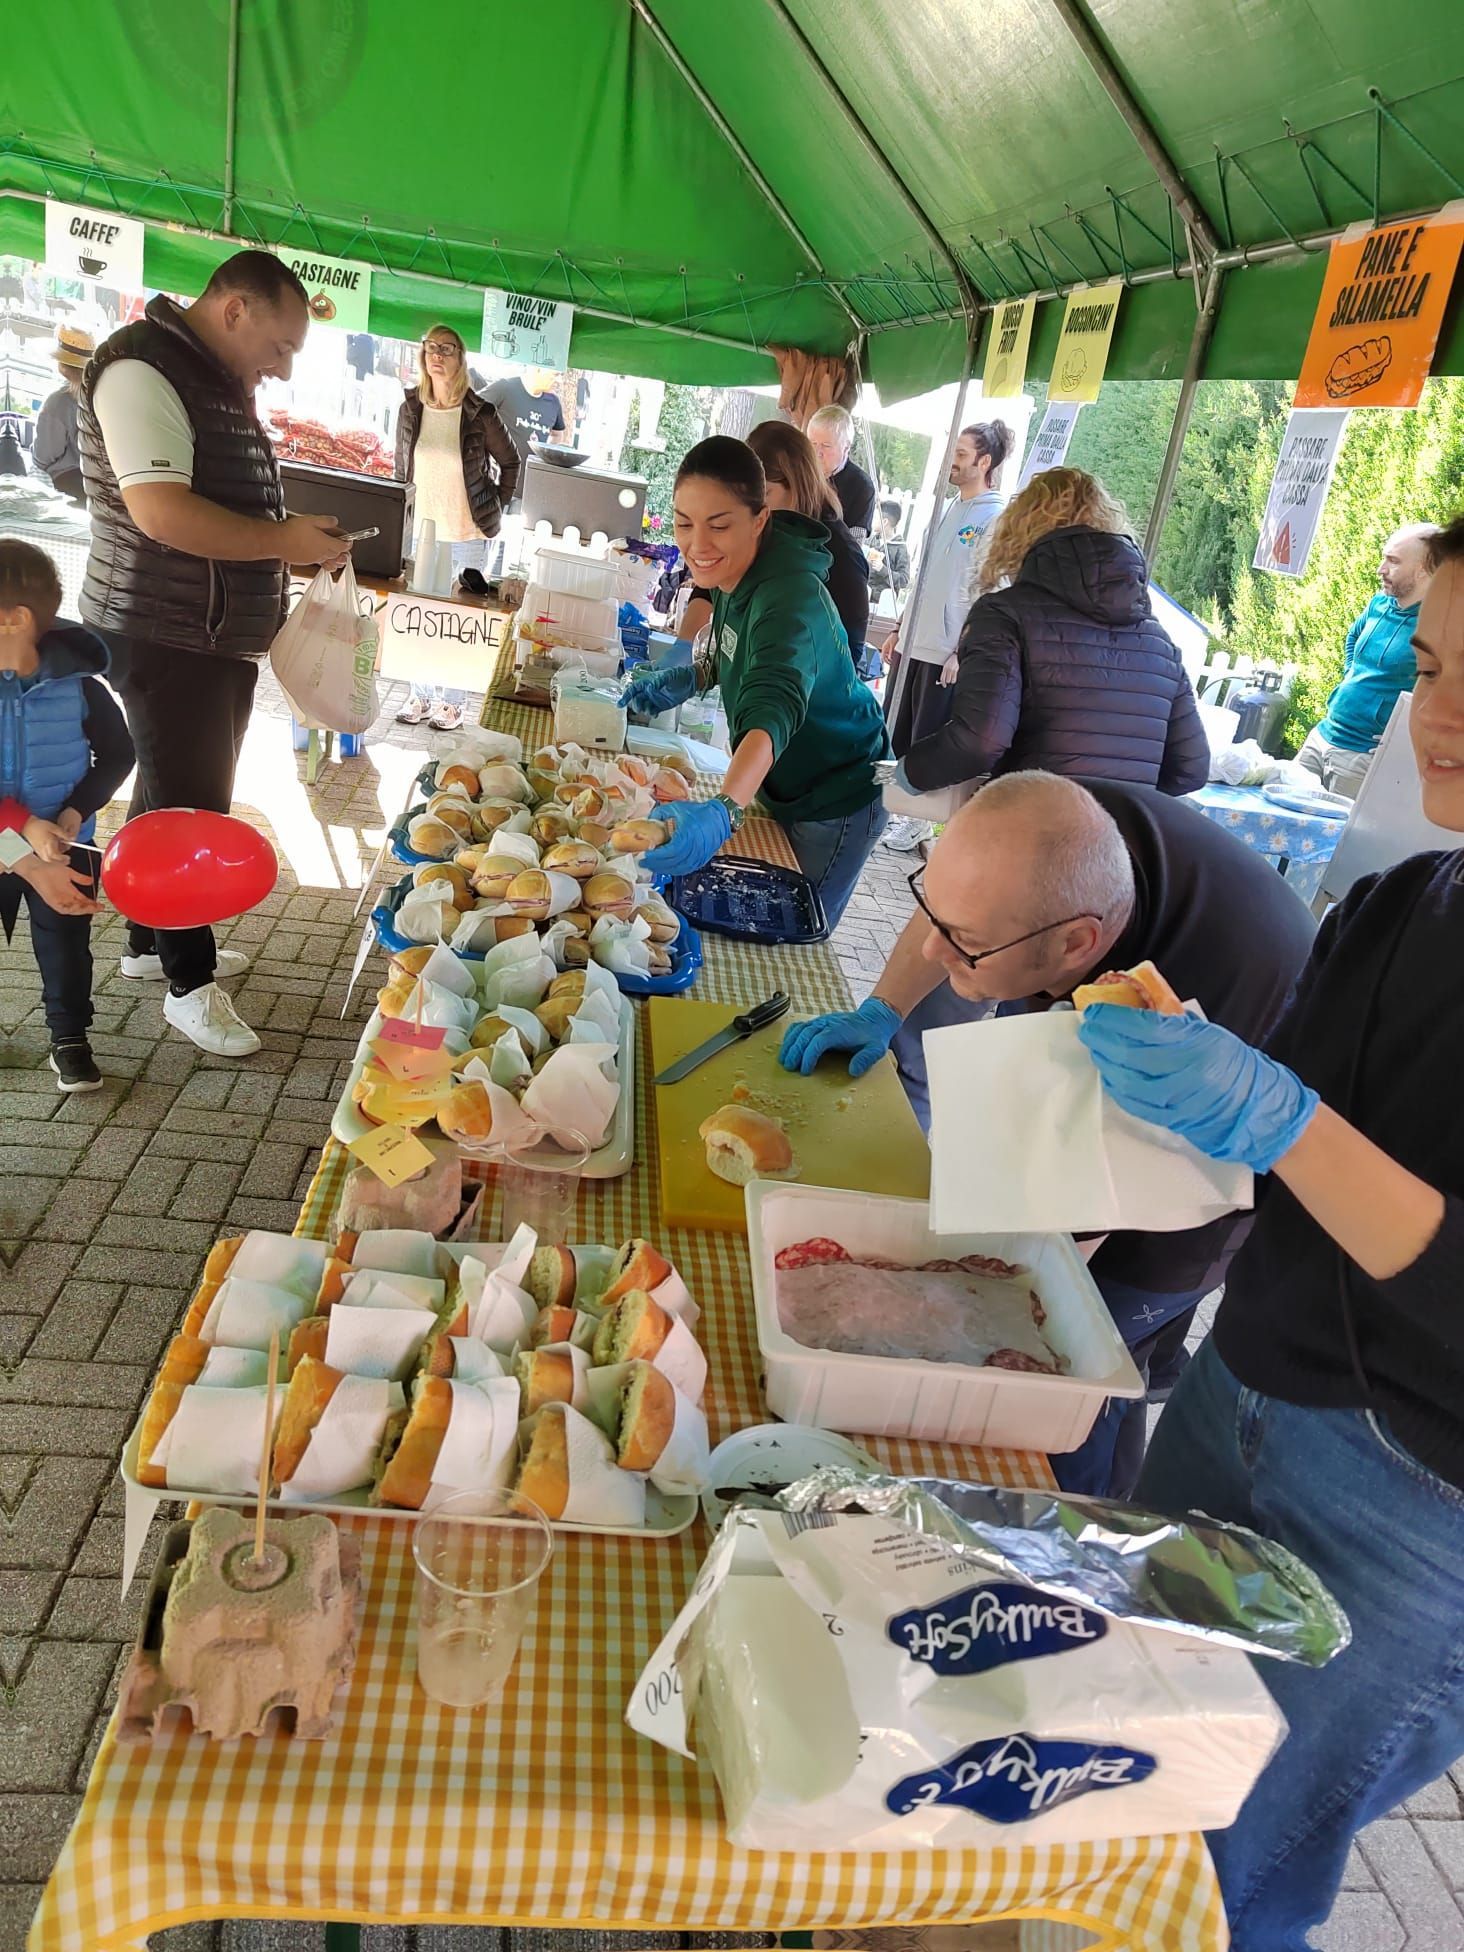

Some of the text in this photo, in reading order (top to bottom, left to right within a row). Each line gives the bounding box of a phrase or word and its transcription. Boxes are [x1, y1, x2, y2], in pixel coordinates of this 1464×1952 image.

[69, 217, 120, 245] CAFFE'
[1354, 226, 1425, 280] PANE E
[291, 260, 361, 290] CASTAGNE
[505, 293, 557, 318] VINO/VIN
[1329, 272, 1431, 328] SALAMELLA
[508, 311, 547, 331] BRULE'
[1289, 437, 1328, 460] PASSARE
[1282, 483, 1310, 506] CASSA
[391, 603, 502, 648] CASTAGNE
[904, 1590, 1097, 1661] BulkySoft
